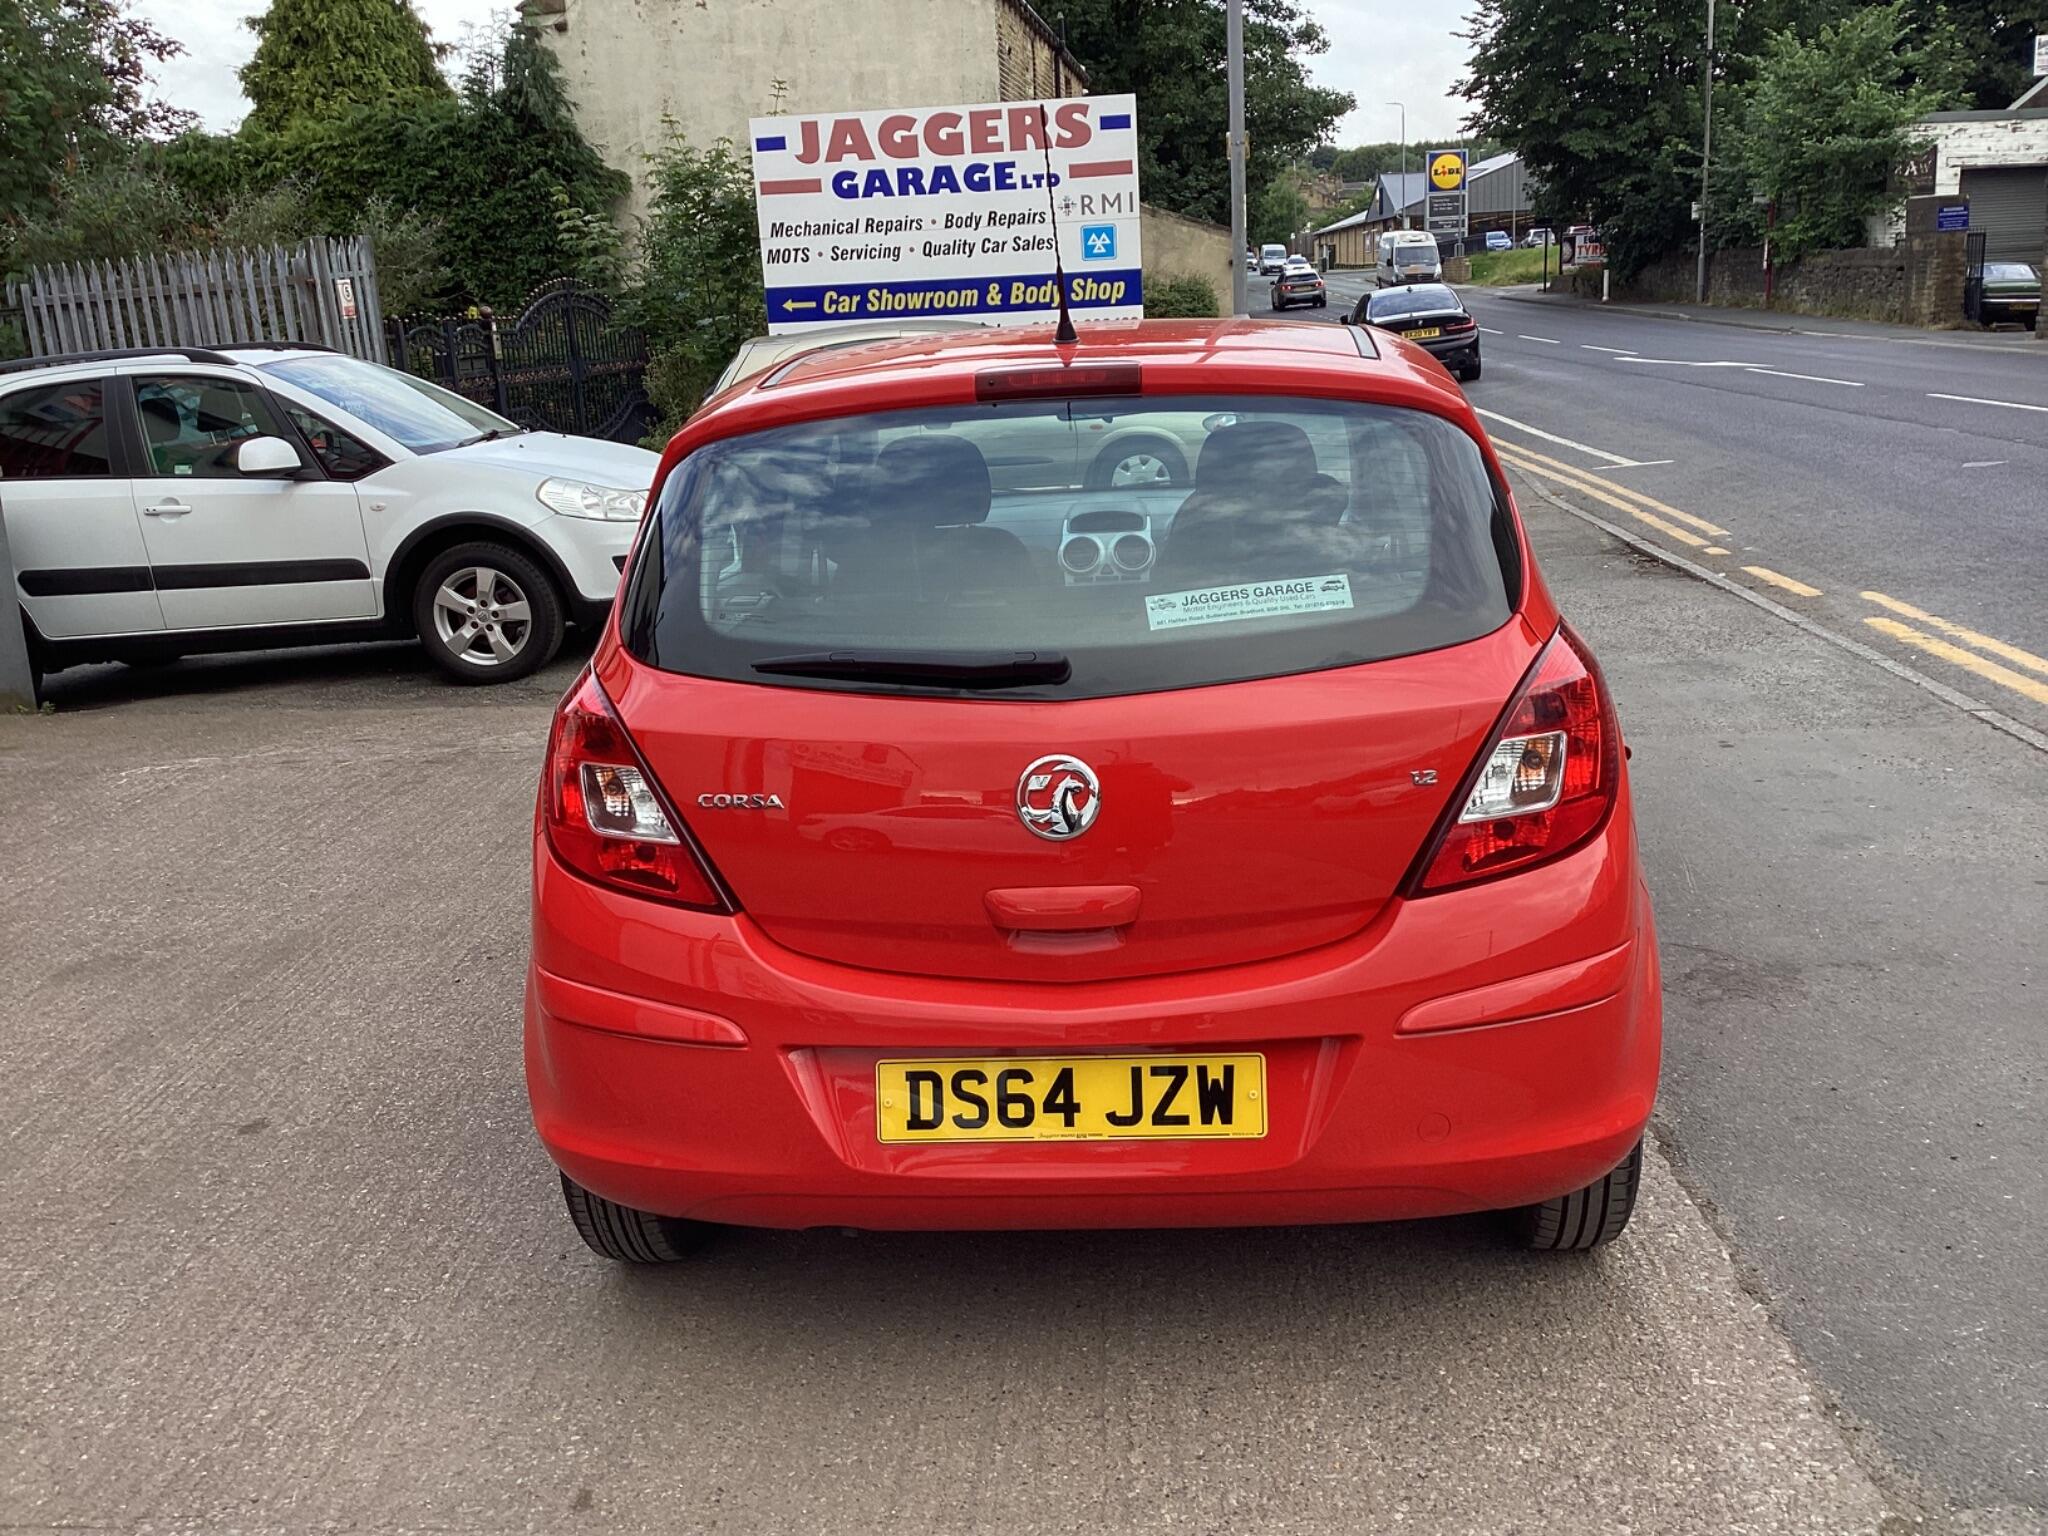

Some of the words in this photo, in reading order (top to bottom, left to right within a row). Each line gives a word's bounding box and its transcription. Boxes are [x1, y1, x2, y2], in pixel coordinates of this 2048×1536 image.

[795, 103, 1092, 164] JAGGERS
[832, 161, 1017, 199] GARAGE
[1021, 173, 1061, 189] LTD
[1080, 192, 1134, 215] RMI
[770, 218, 860, 238] Mechanical
[865, 215, 923, 235] Repairs
[944, 212, 982, 231] Body
[987, 208, 1046, 229] Repairs
[767, 247, 810, 264] MOTS
[830, 243, 901, 262] Servicing
[922, 236, 976, 258] Quality
[981, 237, 1008, 254] Car
[1012, 235, 1054, 251] Sales
[823, 291, 860, 314] Car
[867, 288, 978, 312] Showroom
[986, 283, 1002, 306] &
[1010, 280, 1060, 307] Body
[1071, 278, 1125, 304] Shop
[1182, 588, 1249, 606] JAGGERS
[1253, 581, 1314, 597] GARAGE
[697, 793, 785, 809] CORSA
[905, 1067, 1081, 1131] DS64
[1105, 1065, 1234, 1126] JZW
